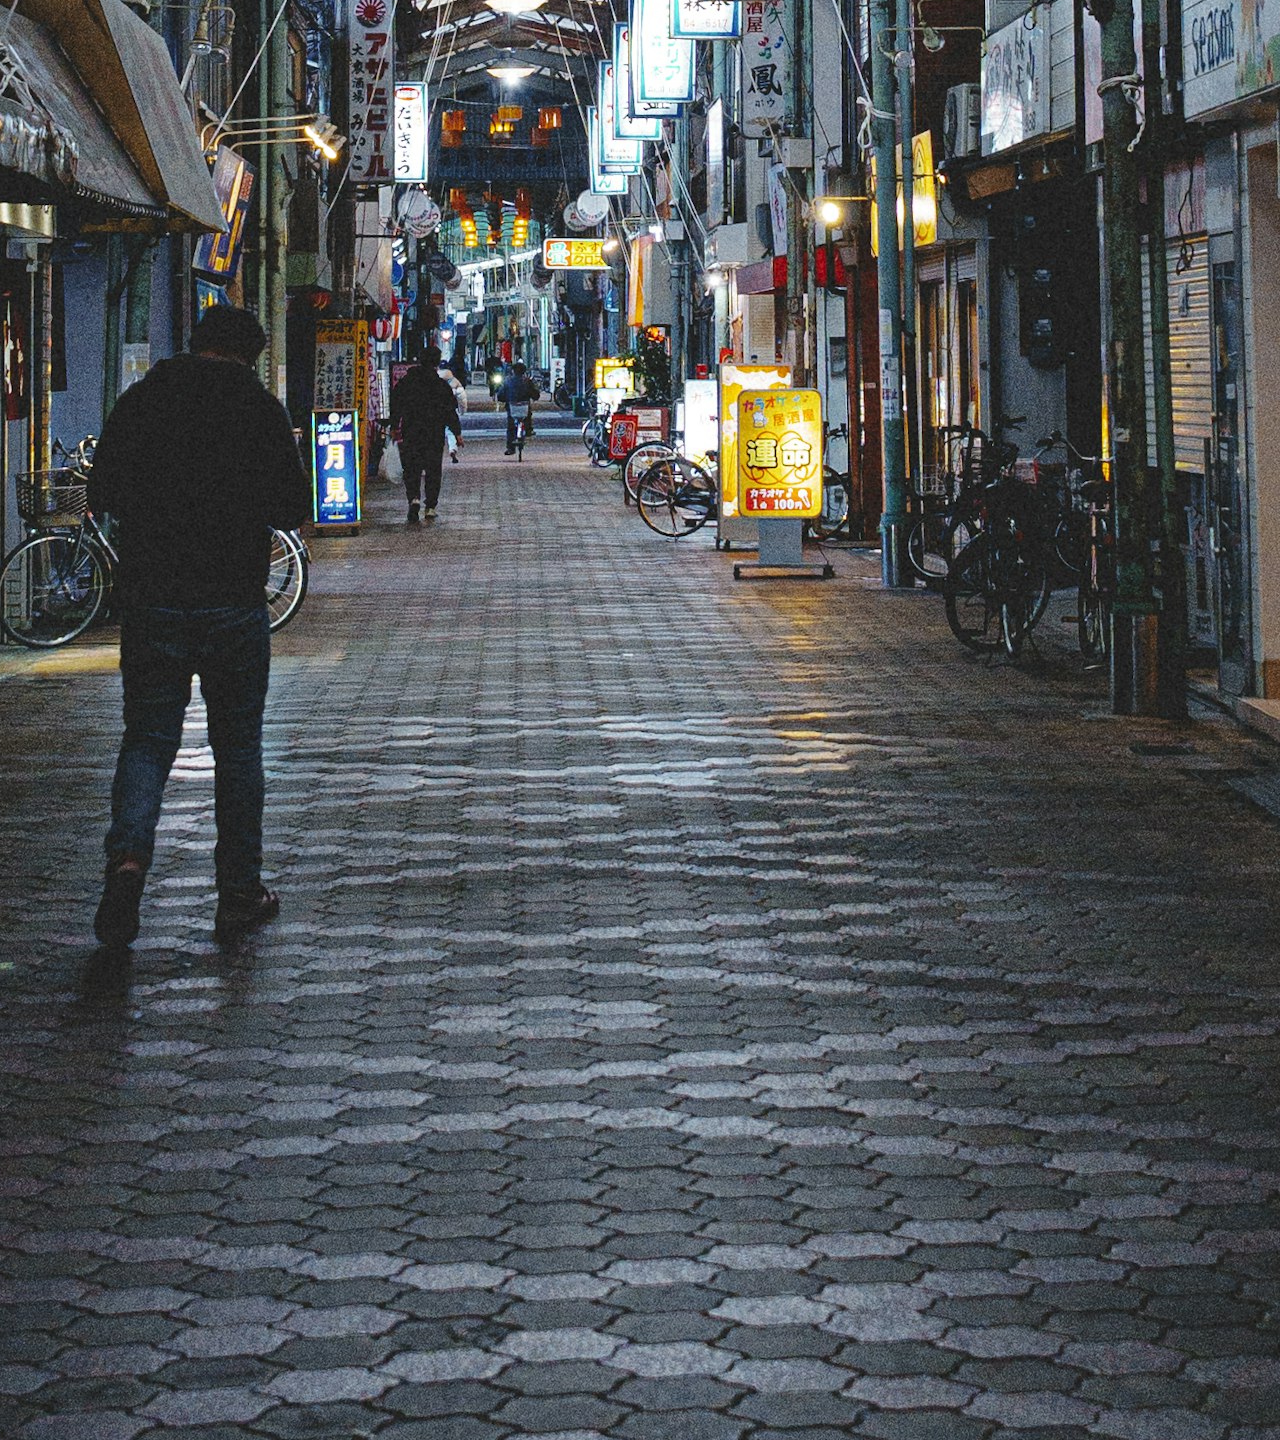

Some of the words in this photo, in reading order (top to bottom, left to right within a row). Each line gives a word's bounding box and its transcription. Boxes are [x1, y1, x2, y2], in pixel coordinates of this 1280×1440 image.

[351, 43, 365, 104] 大衆酒場
[747, 63, 783, 96] 鳳
[363, 32, 390, 178] アサヒビール
[350, 113, 366, 171] みやこ
[547, 241, 571, 266] 畳
[575, 242, 602, 254] ふす
[742, 395, 787, 413] カラオケ
[773, 408, 816, 427] 居酒屋
[746, 437, 813, 470] 運命
[323, 443, 349, 504] 月見
[749, 487, 785, 499] カラオケ
